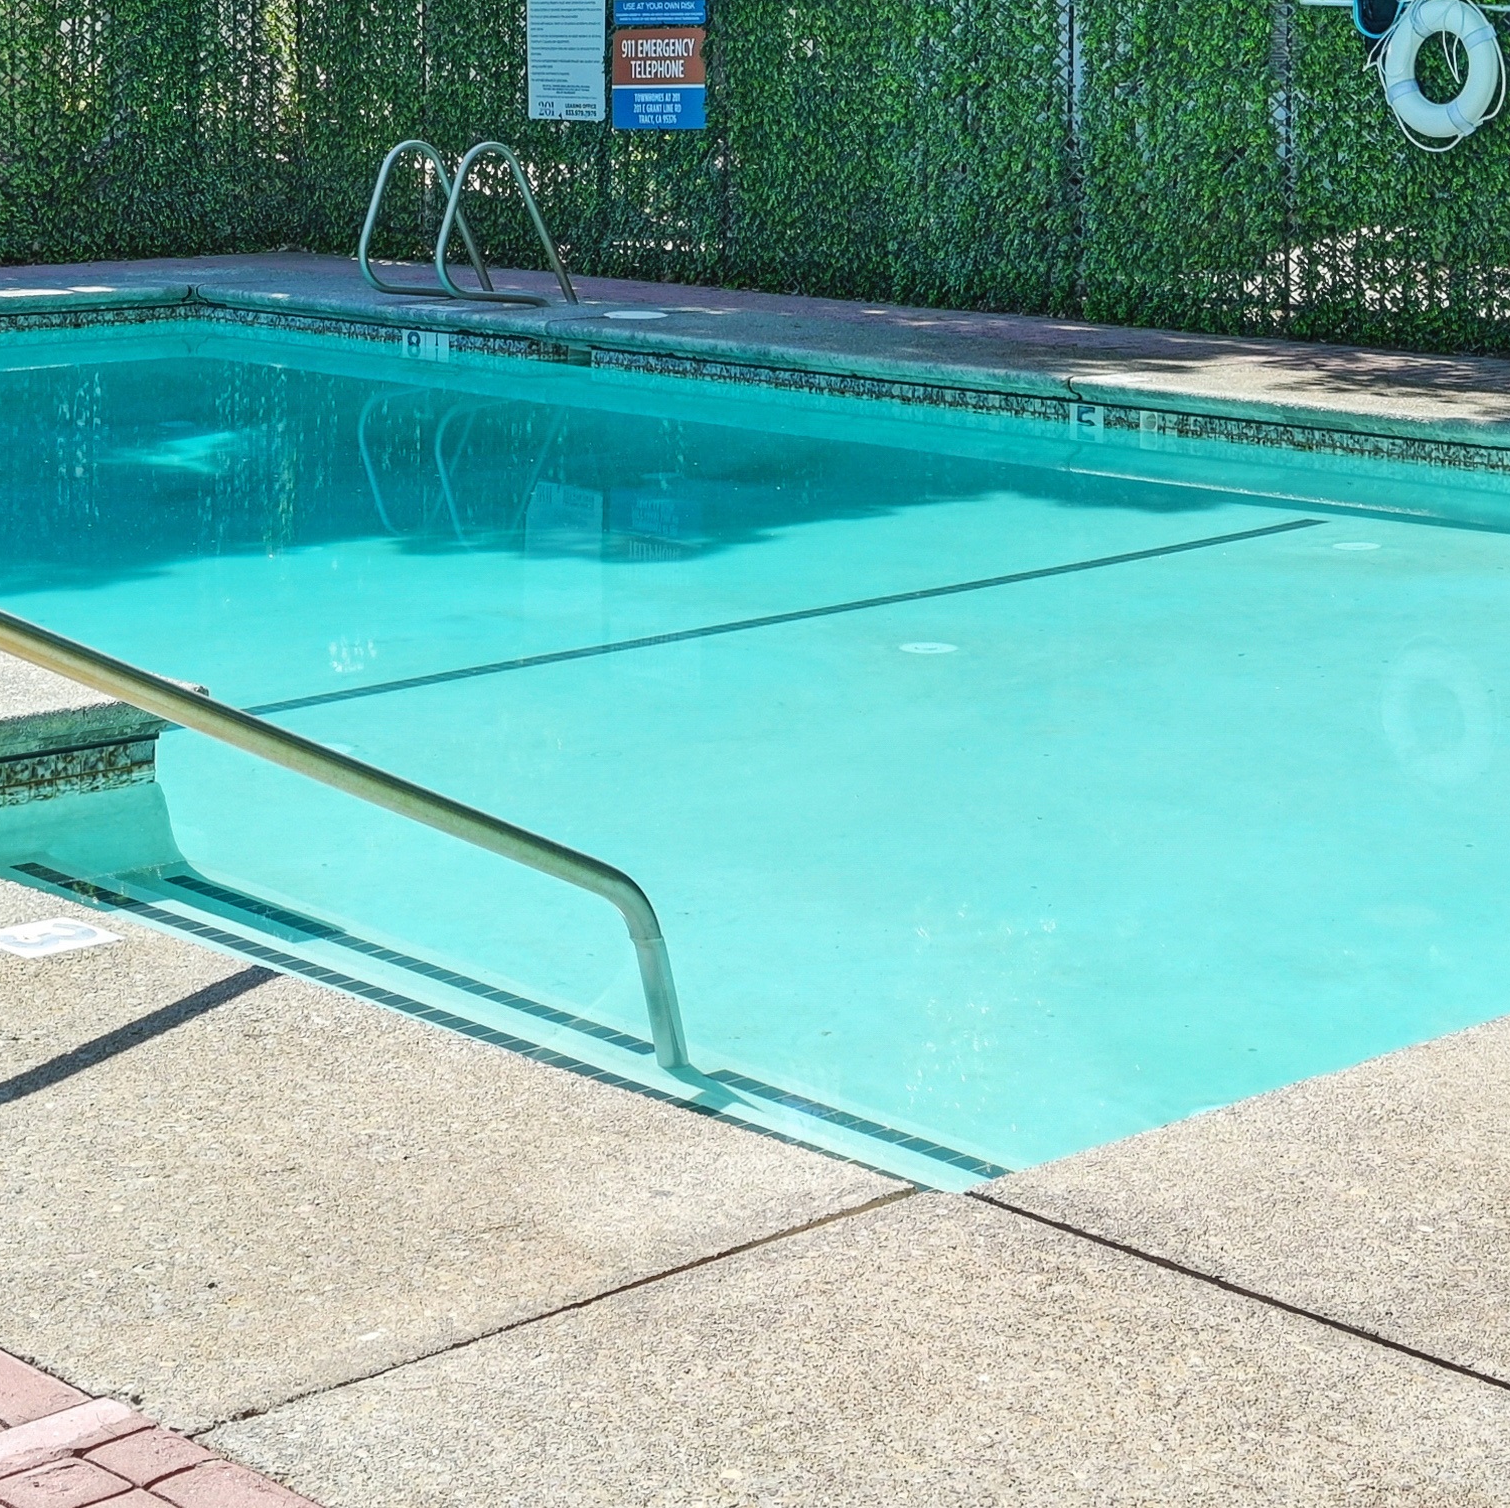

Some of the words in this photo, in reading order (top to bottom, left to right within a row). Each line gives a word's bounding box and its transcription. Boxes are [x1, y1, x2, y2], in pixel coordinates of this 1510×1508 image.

[623, 2, 636, 10] USE
[637, 2, 645, 10] AT
[645, 2, 663, 10] YOUR
[664, 2, 680, 10] OWN
[680, 1, 695, 10] RISK
[621, 39, 636, 58] 911
[637, 38, 695, 57] EMERGENCY
[630, 60, 685, 78] TELEPHONE
[634, 93, 665, 102] TOWNHOMES
[665, 93, 672, 102] AT
[672, 93, 681, 102] 201
[633, 103, 641, 113] 201
[642, 103, 646, 113] E
[646, 103, 662, 113] GRANT
[662, 103, 674, 113] LINE
[674, 103, 682, 113] RD
[638, 114, 655, 125] TRACY,
[655, 114, 662, 123] CA
